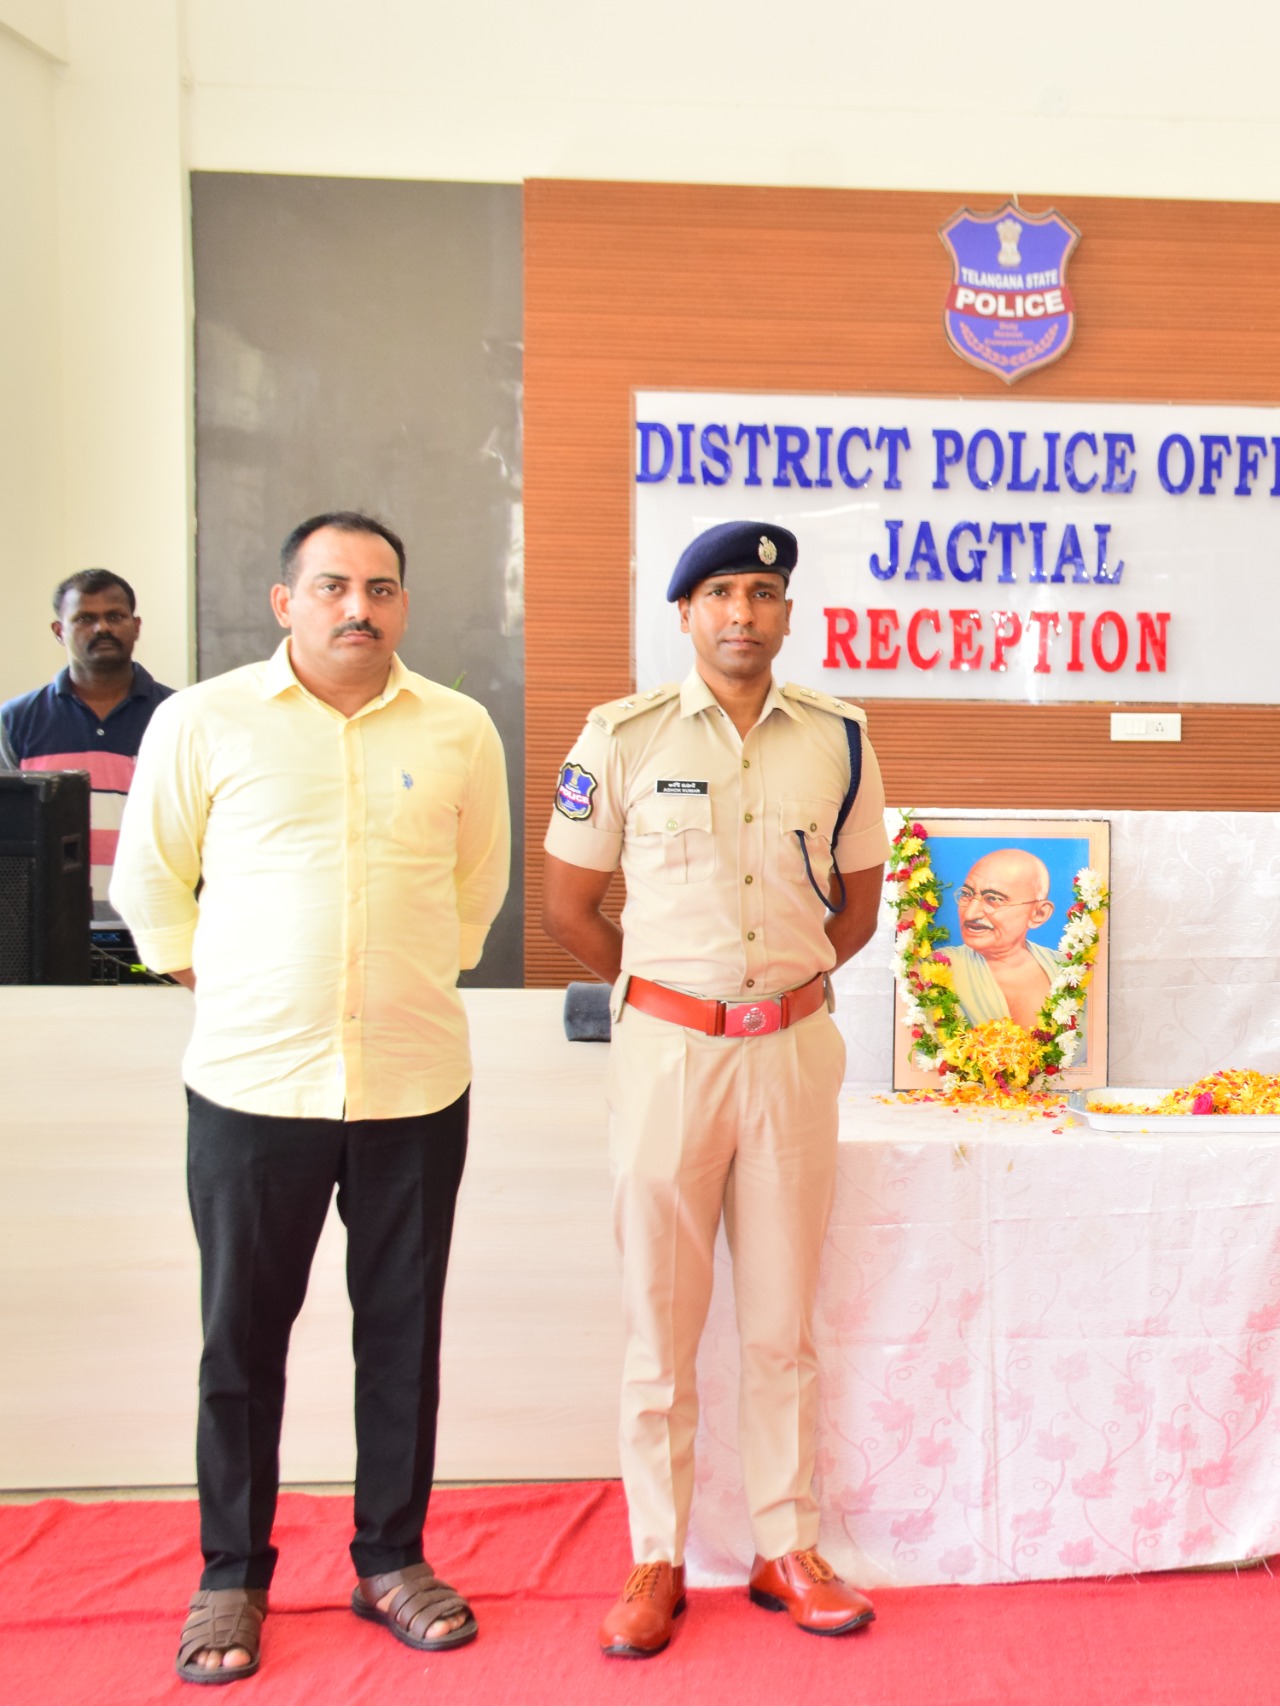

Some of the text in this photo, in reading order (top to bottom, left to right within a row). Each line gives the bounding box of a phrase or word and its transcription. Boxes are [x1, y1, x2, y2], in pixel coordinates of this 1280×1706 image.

[955, 286, 1065, 318] POLICE
[961, 266, 1058, 290] TELANGANA STATE
[636, 422, 910, 489] DISTRICT
[932, 428, 1136, 493] POLICE
[869, 520, 1123, 584] JAGTIAL
[823, 607, 1171, 673] RECEPTION
[560, 784, 590, 806] POLICE
